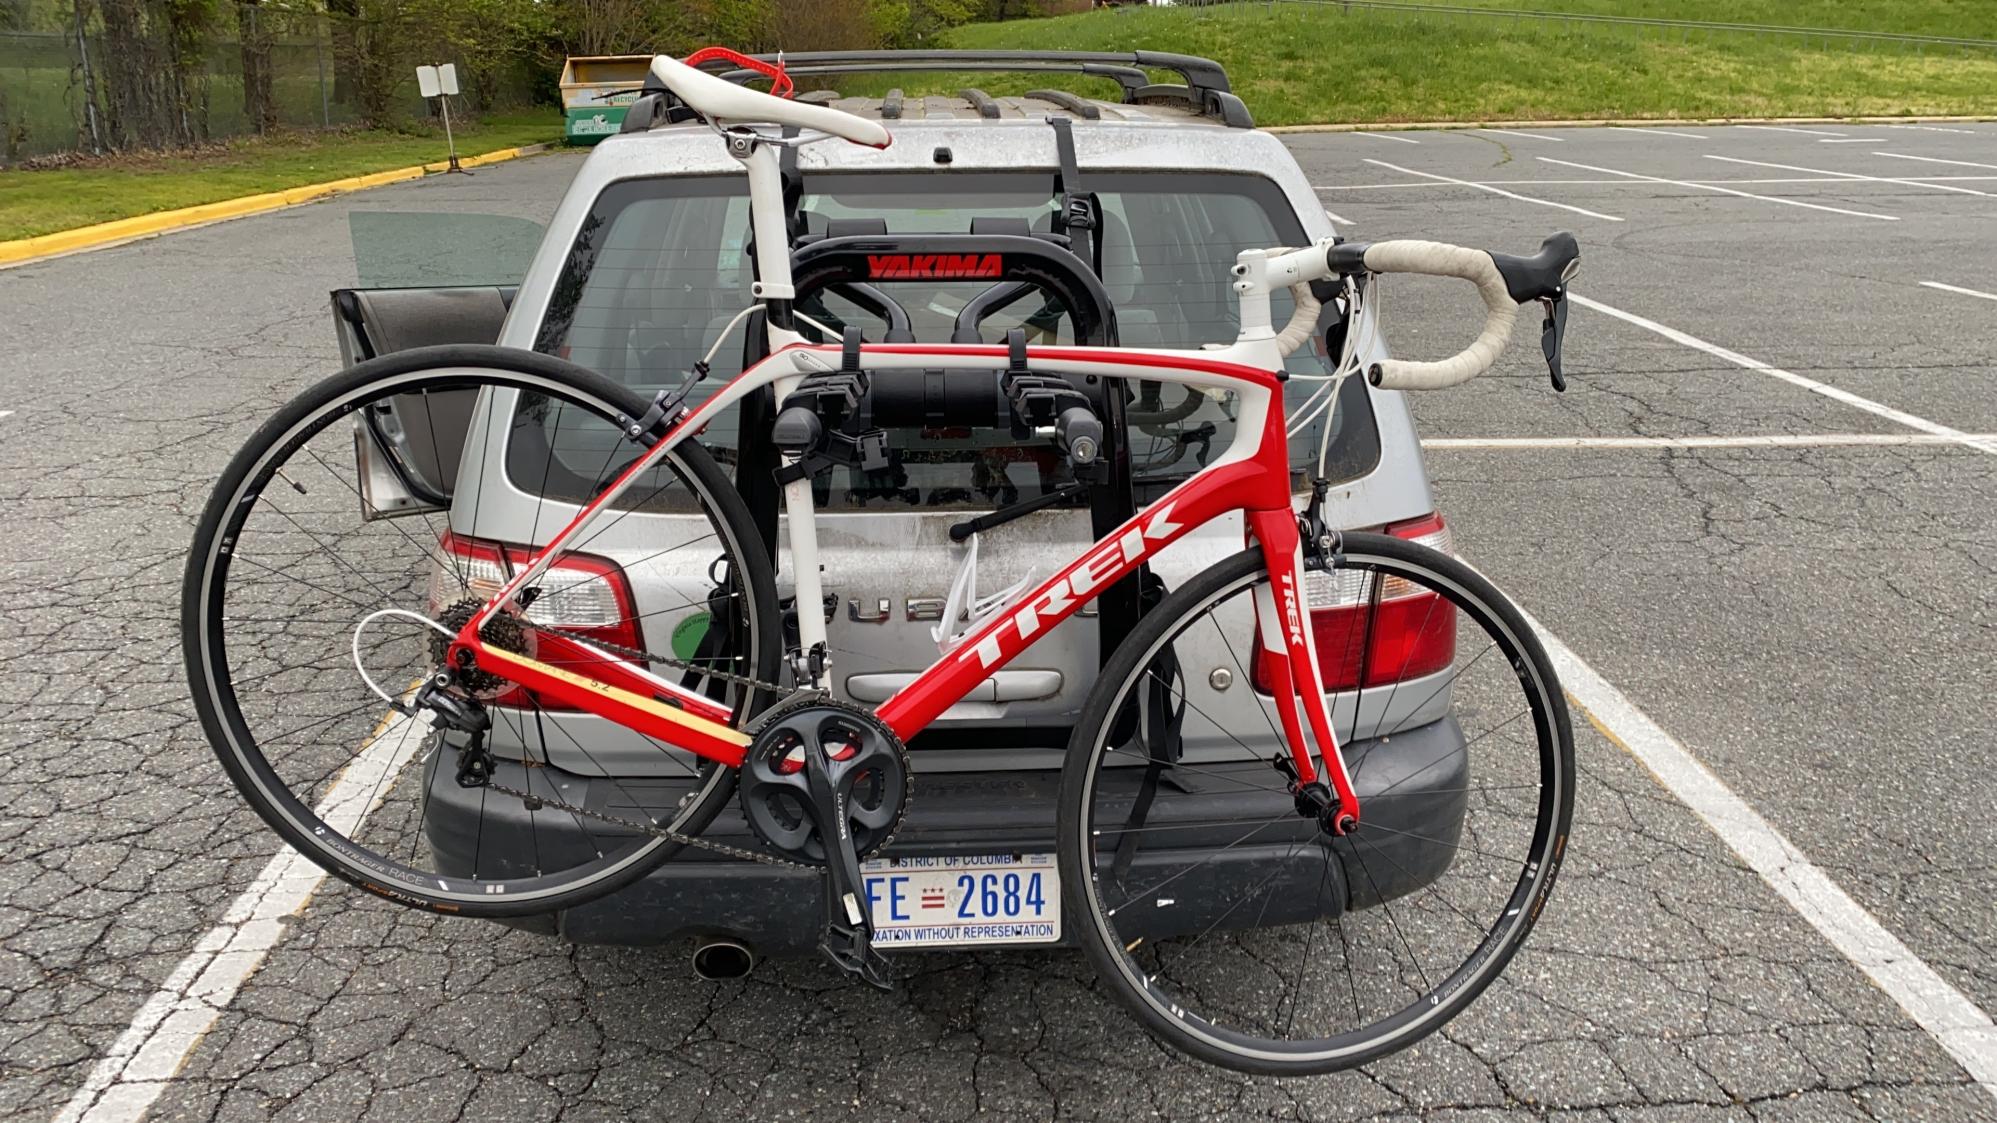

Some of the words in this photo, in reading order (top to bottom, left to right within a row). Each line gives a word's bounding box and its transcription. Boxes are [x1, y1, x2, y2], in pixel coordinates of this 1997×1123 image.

[868, 254, 1002, 278] YAKIMA
[958, 500, 1184, 670] TREK
[1281, 570, 1304, 647] TREK
[837, 792, 847, 840] ULTEGRA
[326, 838, 385, 872] BONTRAGER
[388, 867, 425, 886] RACE
[945, 856, 960, 866] OF
[957, 872, 1046, 919] 2684
[873, 928, 911, 942] XATION
[914, 926, 961, 941] WITHOUT
[963, 923, 1054, 939] REPRESENTATION
